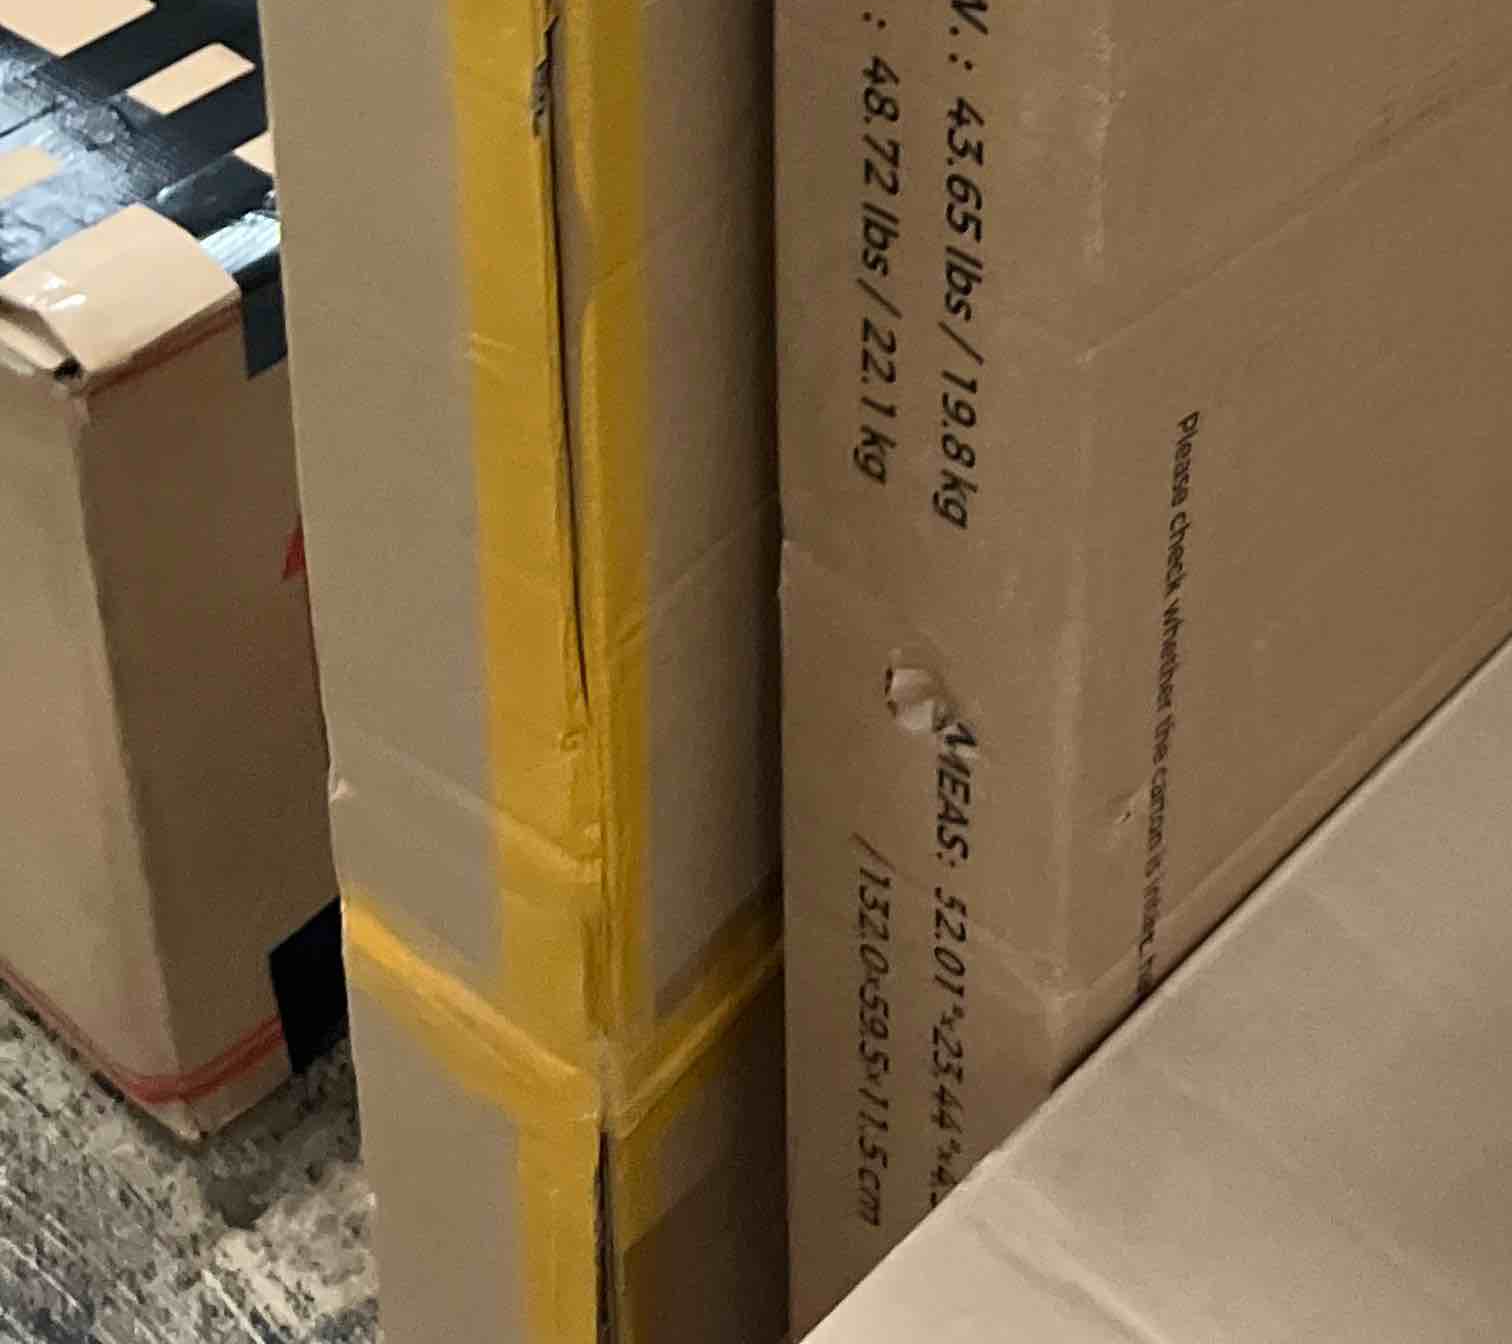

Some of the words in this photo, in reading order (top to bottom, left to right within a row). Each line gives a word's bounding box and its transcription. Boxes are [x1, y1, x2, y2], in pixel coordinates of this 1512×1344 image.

[1169, 410, 1201, 509] Please
[1163, 511, 1192, 599] check
[1155, 599, 1185, 713] whether
